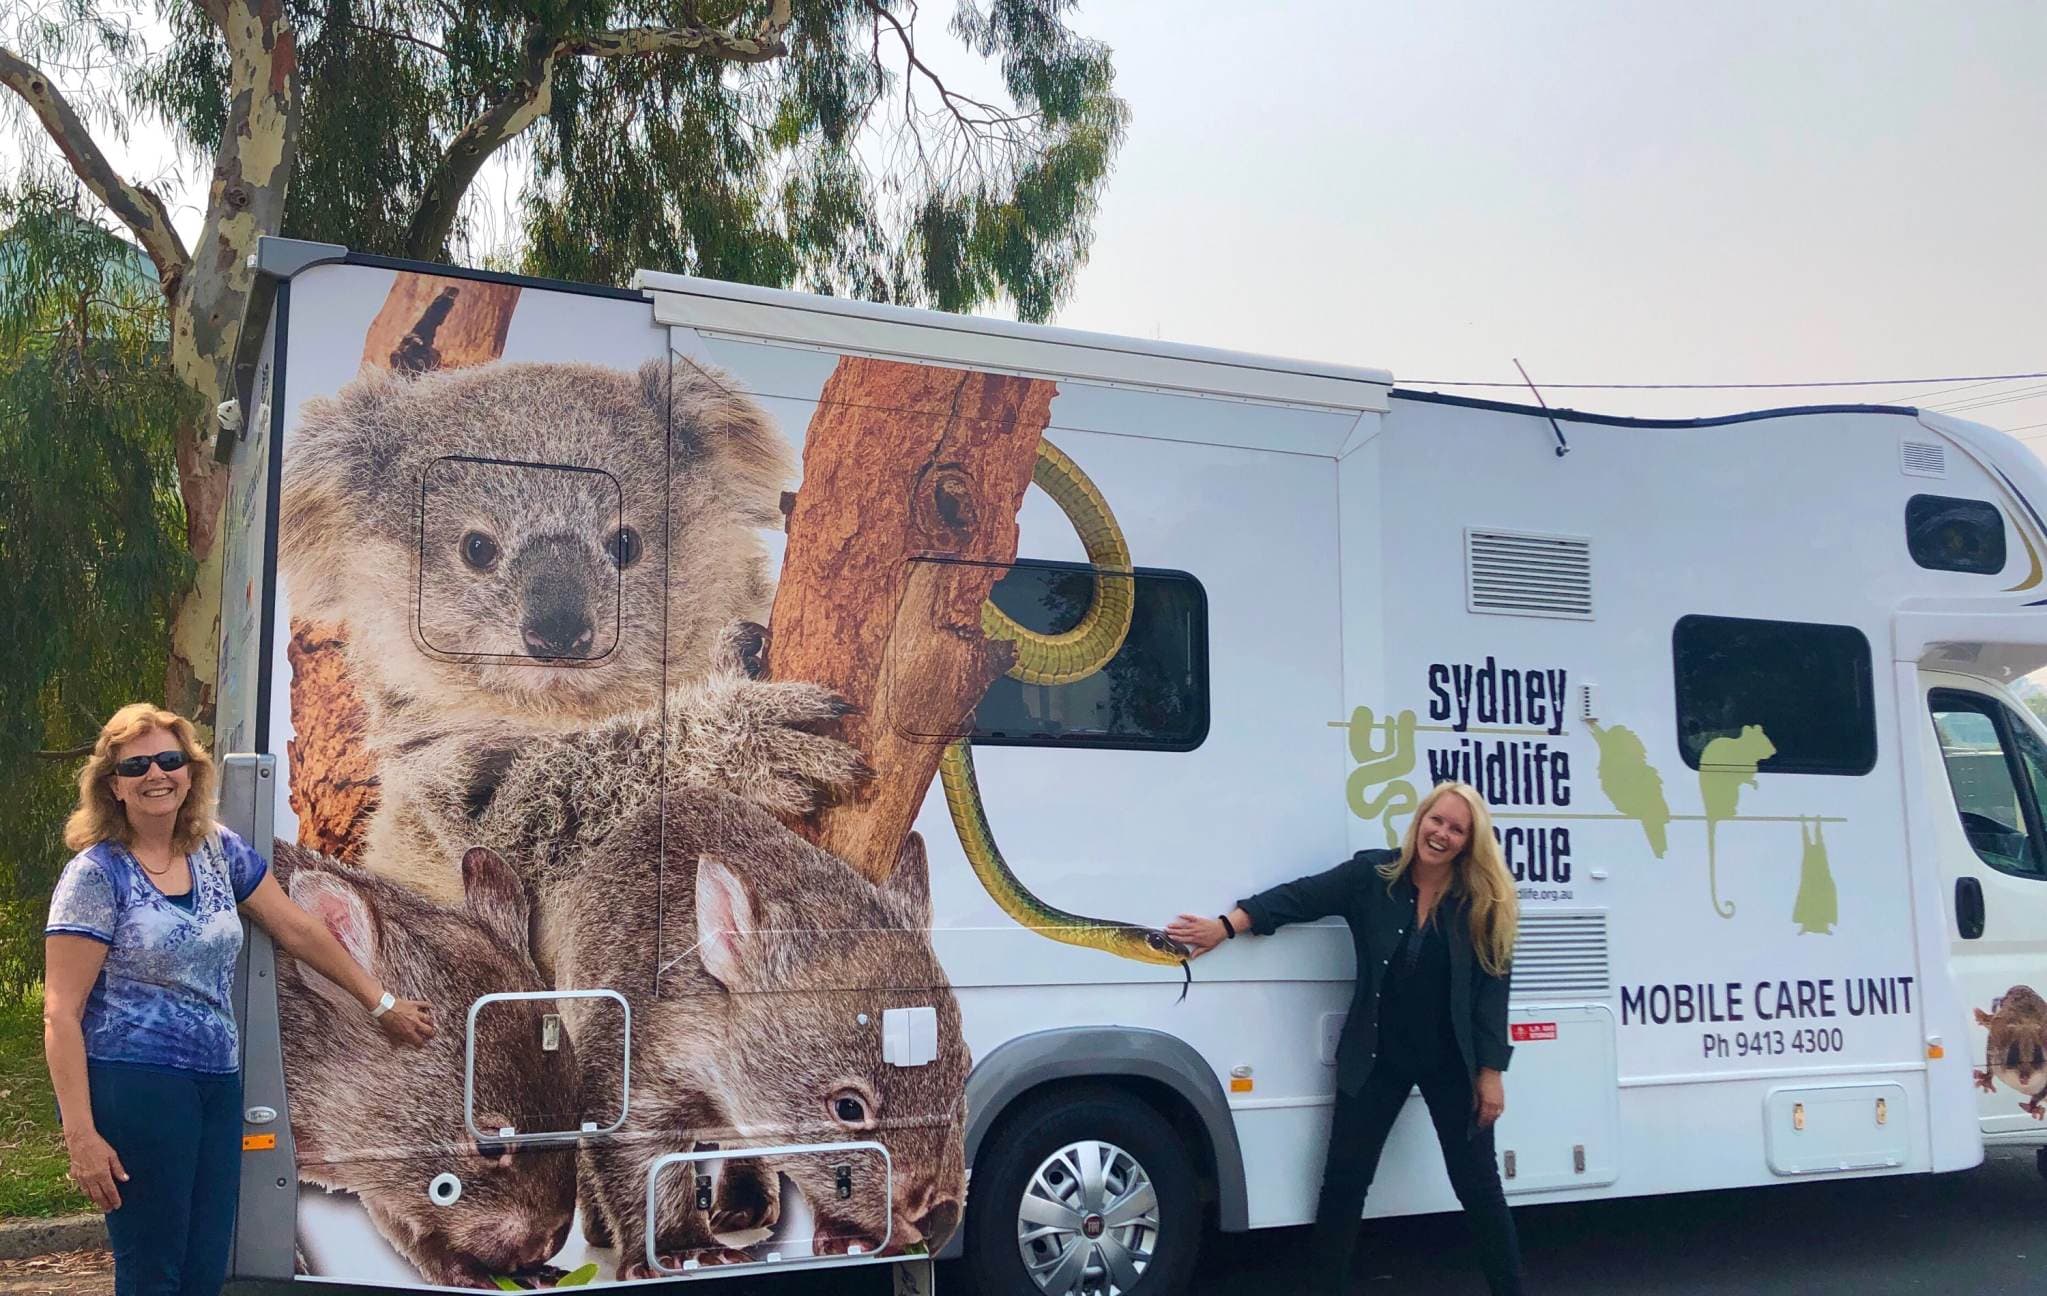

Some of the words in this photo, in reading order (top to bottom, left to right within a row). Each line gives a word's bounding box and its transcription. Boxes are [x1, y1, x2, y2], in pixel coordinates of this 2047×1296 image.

[1428, 656, 1567, 736] sydney
[1427, 738, 1571, 806] wildlife
[1621, 982, 1744, 1025] MOBILE
[1754, 979, 1836, 1020] CARE
[1845, 977, 1914, 1016] UNIT
[1703, 1033, 1729, 1058] Ph
[1735, 1030, 1785, 1057] 9413
[1791, 1027, 1843, 1053] 4300
